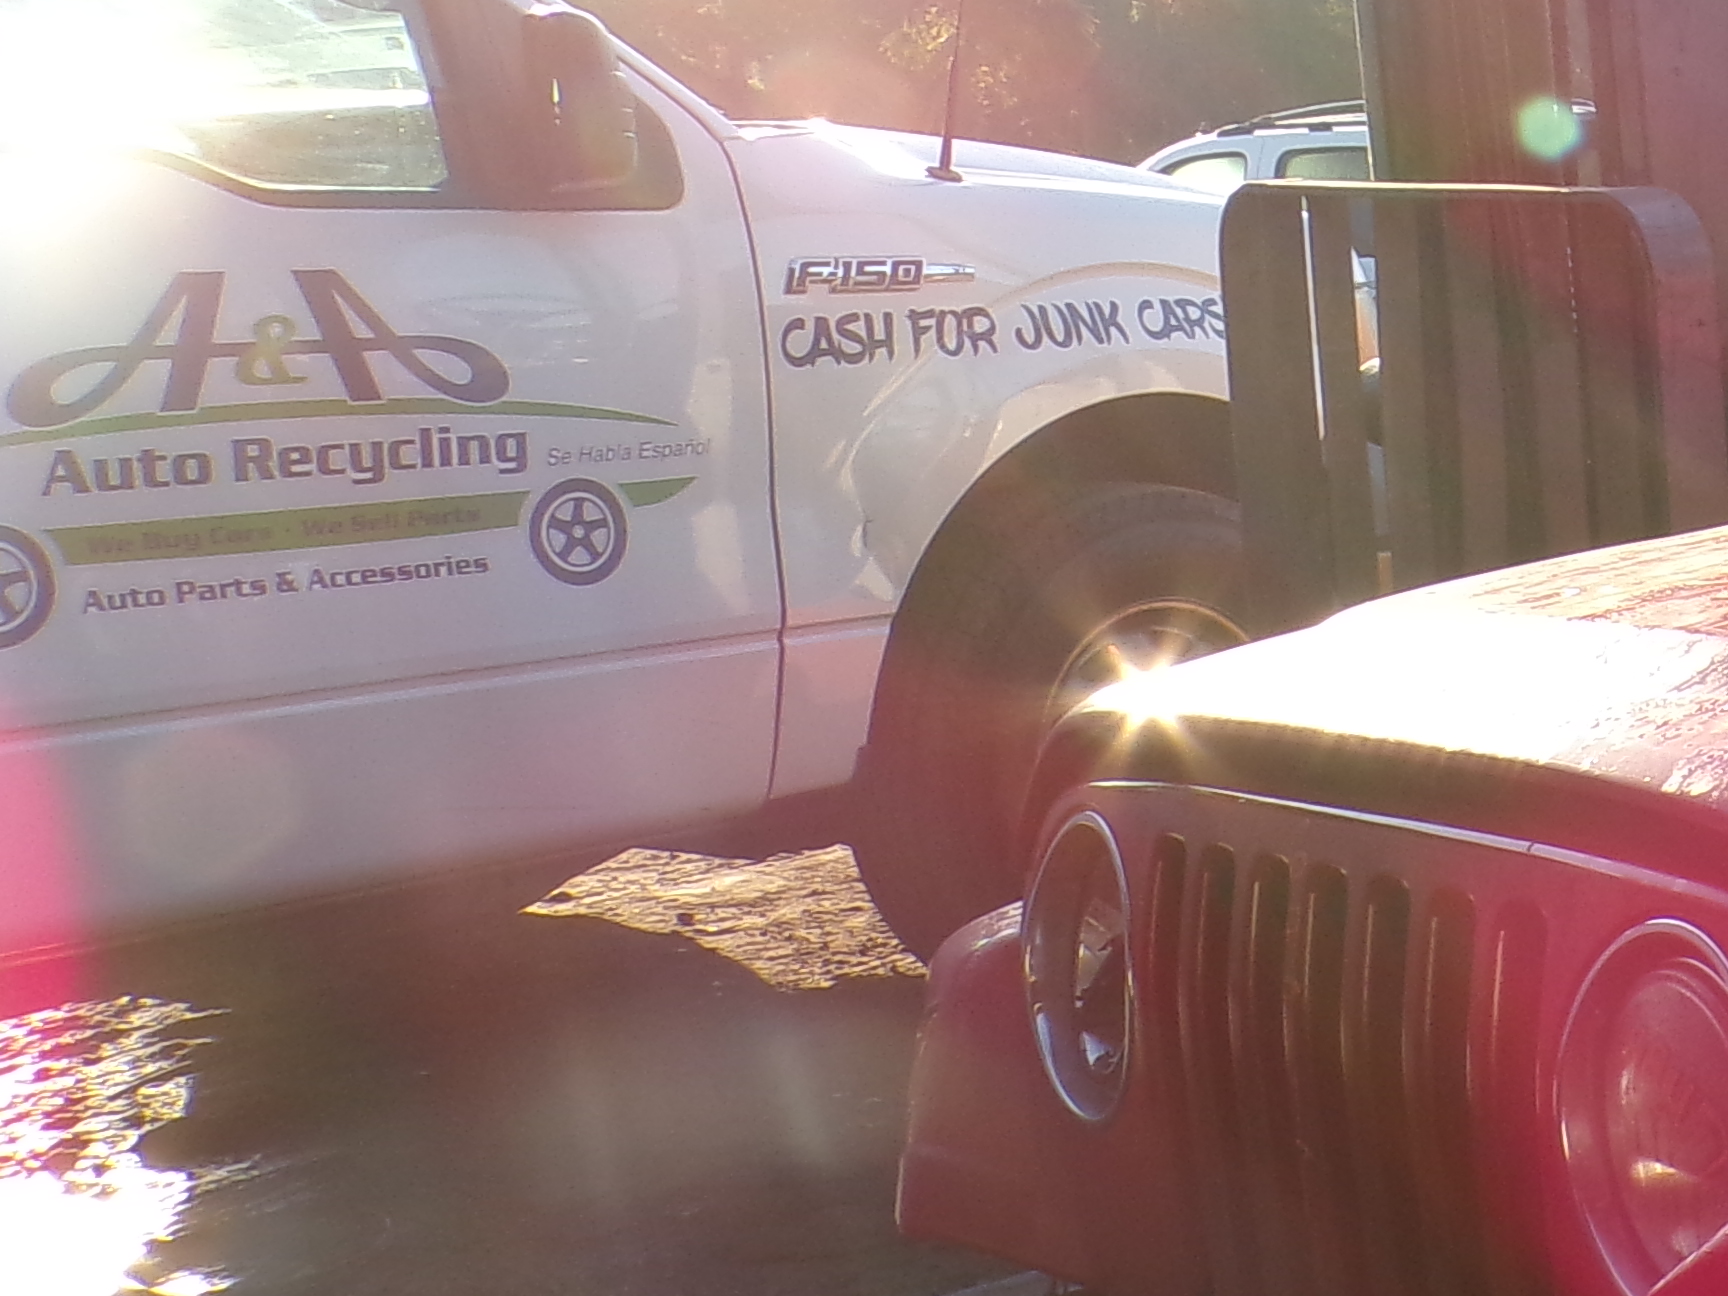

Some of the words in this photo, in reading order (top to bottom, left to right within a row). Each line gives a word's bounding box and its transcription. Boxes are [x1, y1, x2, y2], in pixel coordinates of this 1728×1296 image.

[786, 257, 925, 294] F-150
[781, 311, 894, 368] CASH
[904, 306, 999, 360] FOR
[1014, 299, 1131, 351] JUNK
[1137, 297, 1227, 342] CARS
[42, 448, 214, 497] Auto
[231, 424, 529, 485] Recycling
[547, 447, 572, 467] Se
[578, 444, 632, 464] Habla
[638, 438, 711, 461] Español
[82, 588, 167, 615] Auto
[174, 577, 268, 604] Parts
[275, 570, 299, 594] &
[307, 555, 490, 591] Accessories
